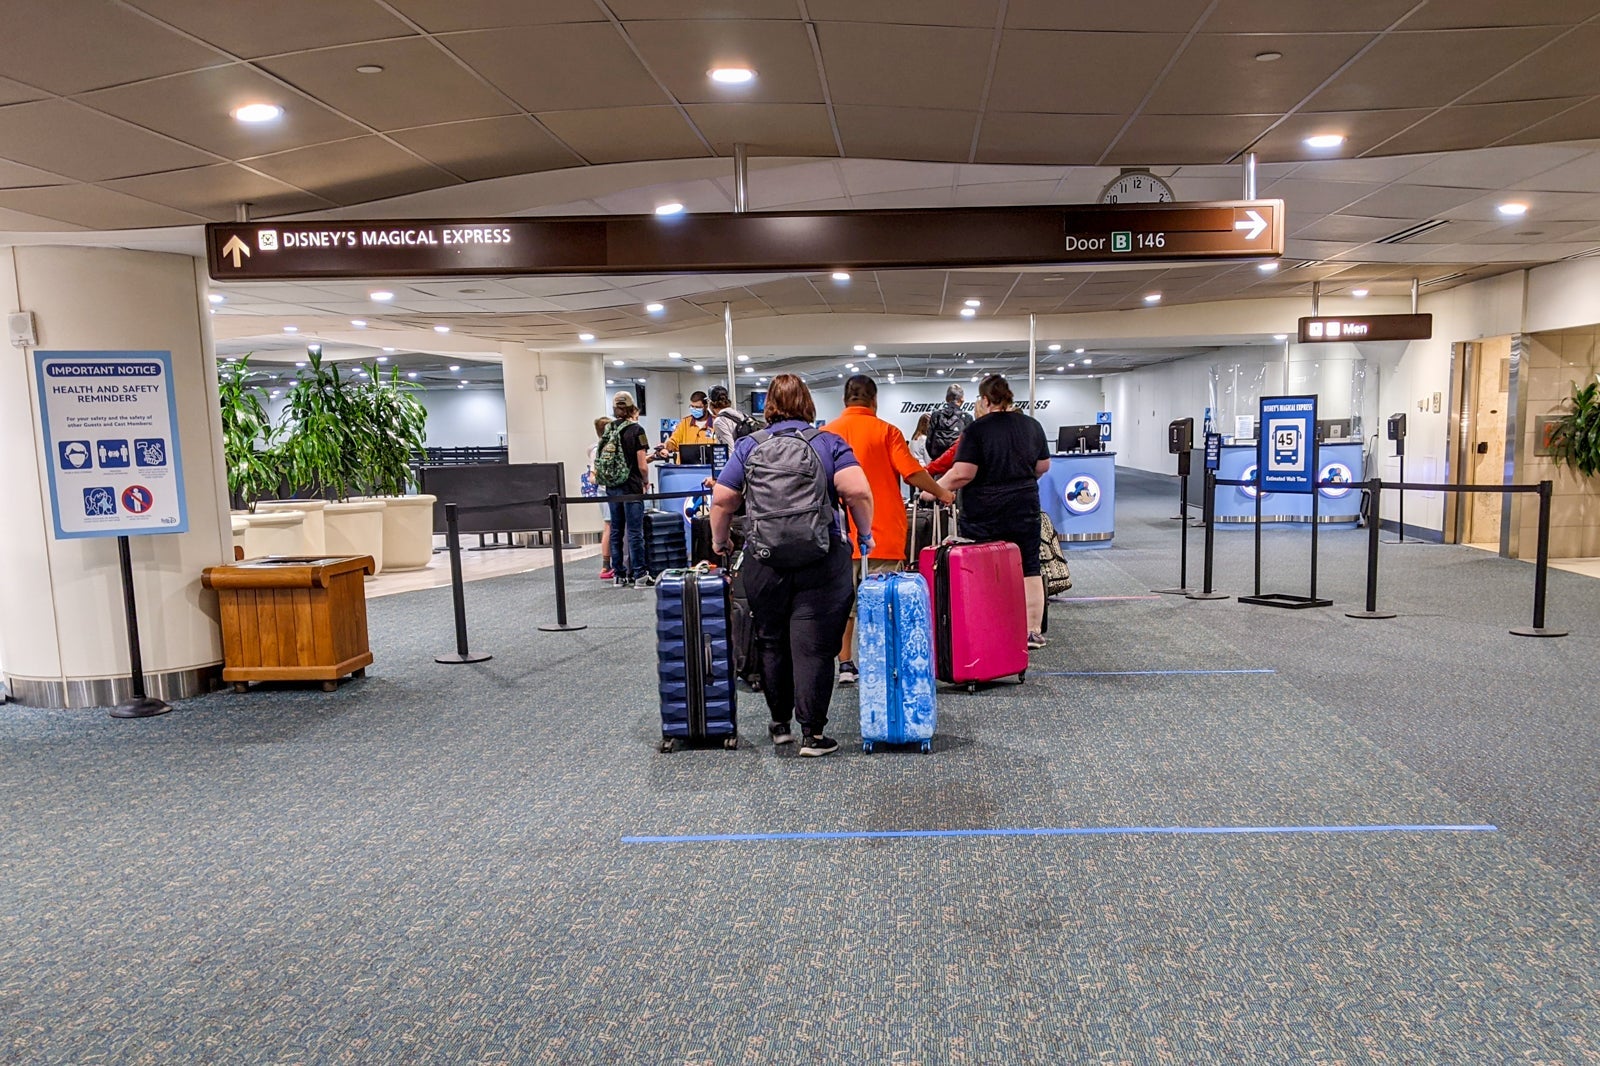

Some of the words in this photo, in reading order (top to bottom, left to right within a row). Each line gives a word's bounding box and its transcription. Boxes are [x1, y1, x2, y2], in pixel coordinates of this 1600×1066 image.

[1120, 183, 1127, 193] 11
[1133, 179, 1142, 189] 12
[1159, 193, 1165, 203] 2
[283, 230, 356, 248] DISNEY'S
[362, 229, 437, 246] MAGICAL
[443, 228, 511, 244] EXPRESS
[1065, 236, 1106, 251] Door
[1115, 234, 1127, 248] B
[1136, 233, 1165, 248] 146
[1343, 323, 1368, 334] Men
[51, 366, 114, 375] IMPORTANT
[117, 365, 157, 374] NOTICE
[53, 385, 93, 394] HEALTH
[97, 385, 119, 393] AND
[122, 385, 159, 393] SAFETY
[78, 394, 138, 403] REMINDERS
[1278, 433, 1293, 445] 45
